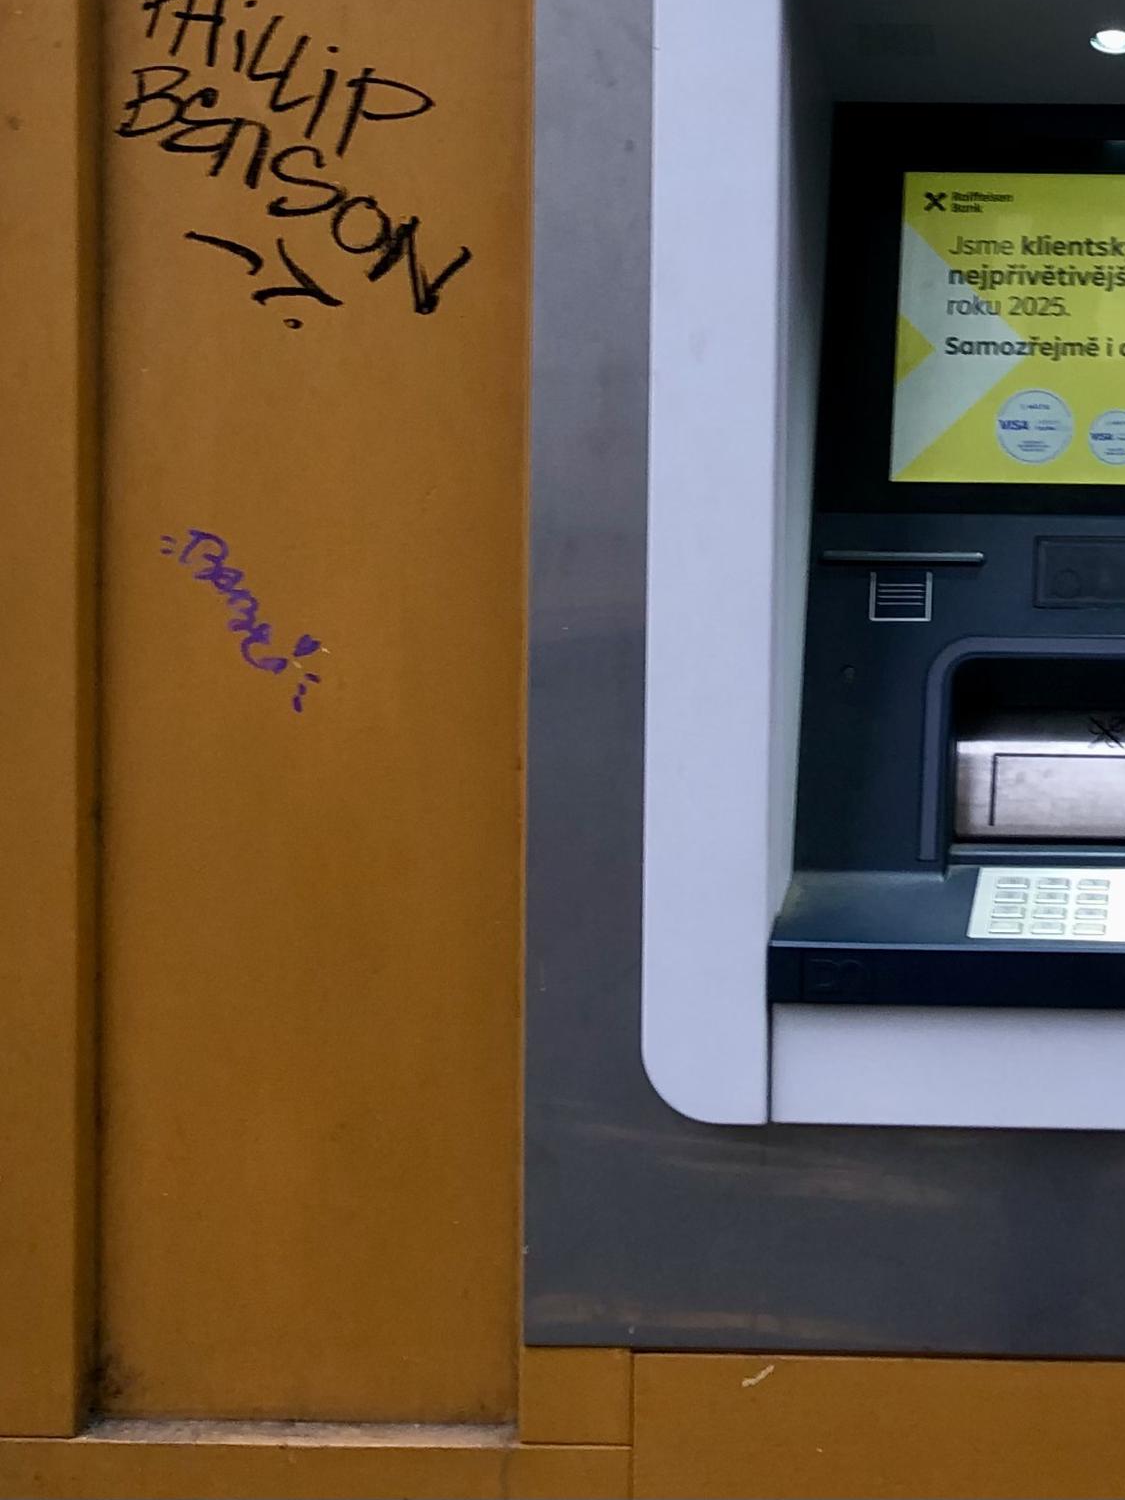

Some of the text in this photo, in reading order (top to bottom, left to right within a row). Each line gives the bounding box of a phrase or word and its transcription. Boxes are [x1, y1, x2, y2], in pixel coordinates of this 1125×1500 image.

[949, 235, 1014, 256] Jsme
[946, 296, 1071, 317] roku 2025.
[945, 336, 1099, 361] Samozřejmě
[1106, 338, 1114, 357] i
